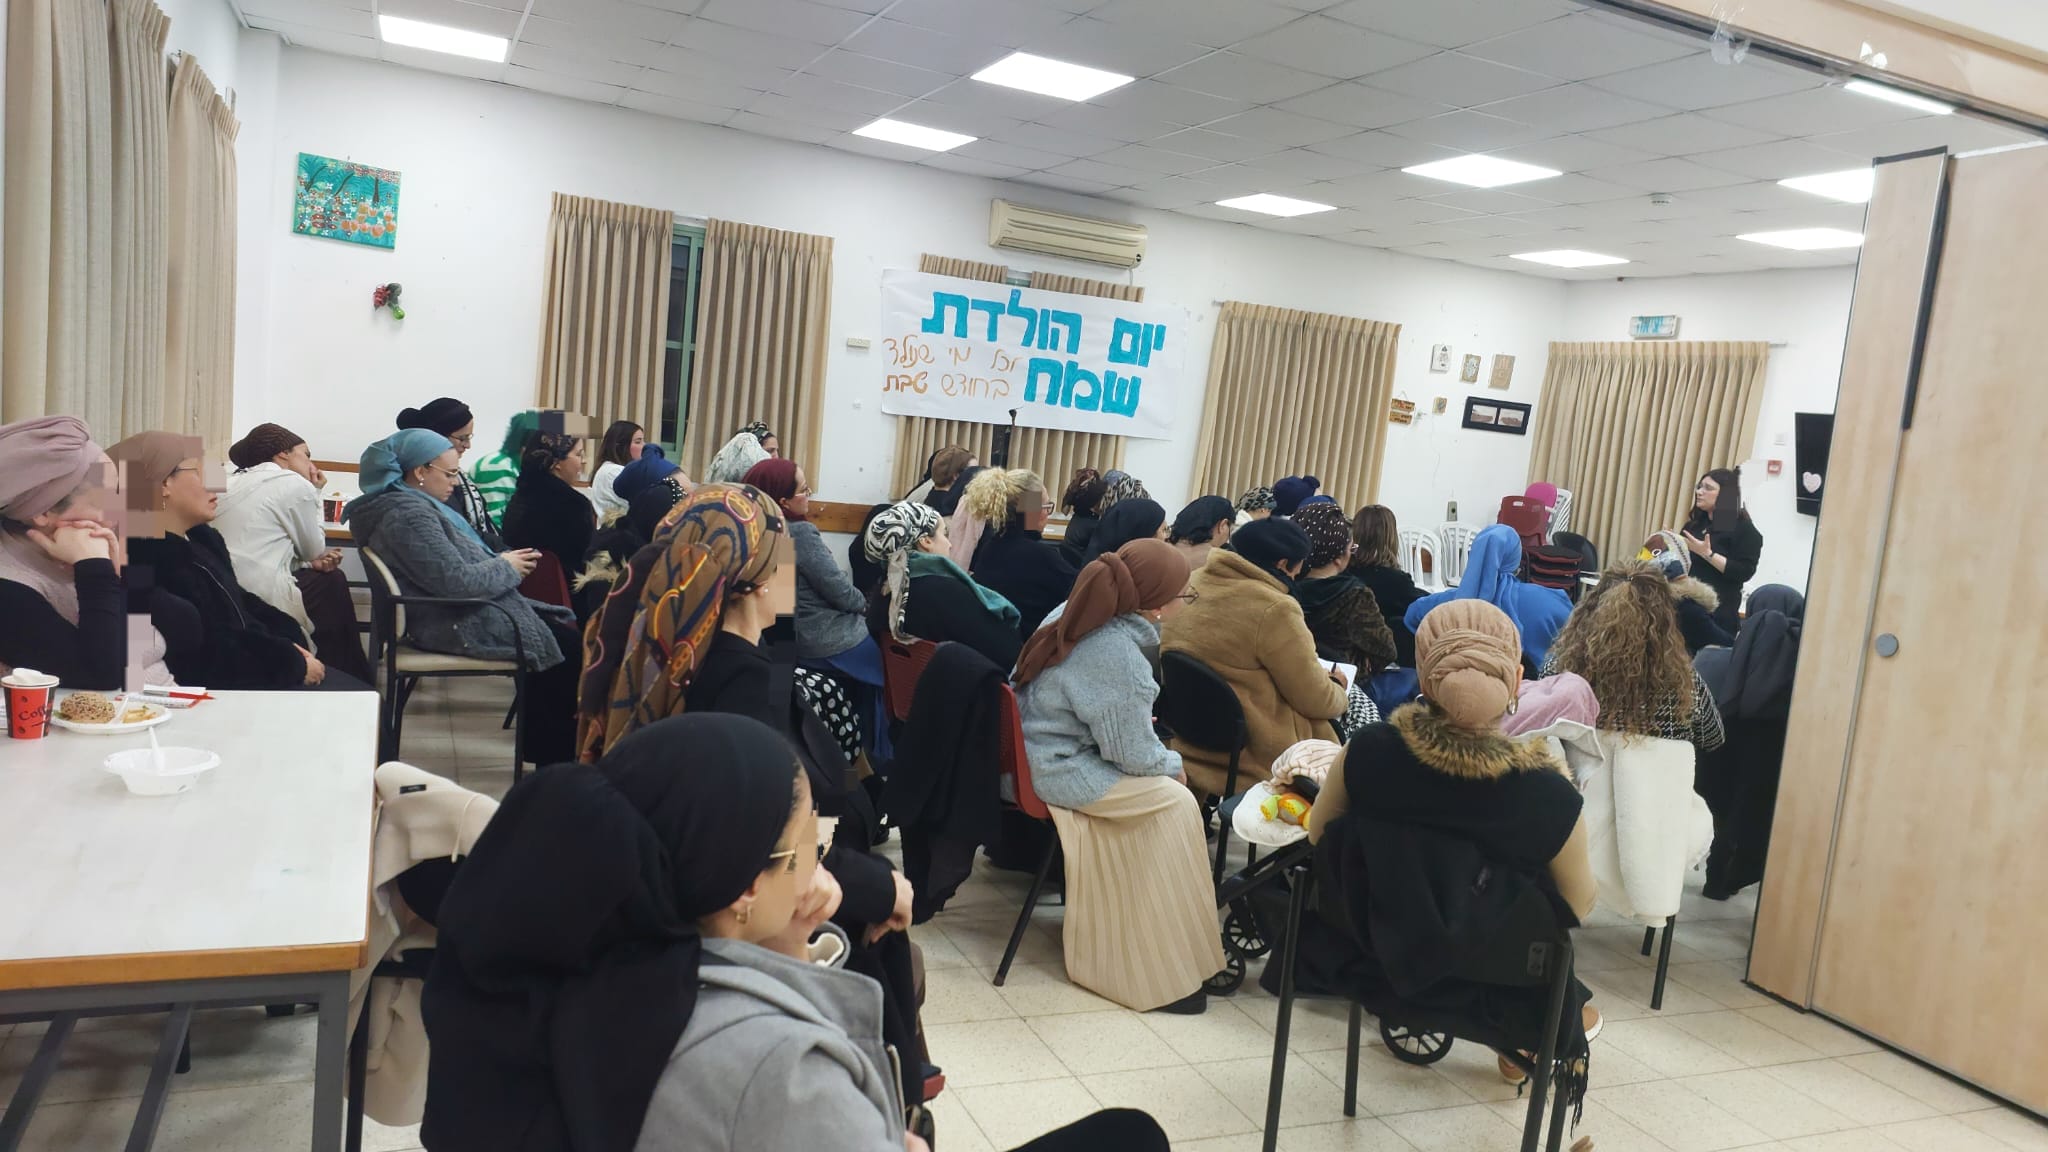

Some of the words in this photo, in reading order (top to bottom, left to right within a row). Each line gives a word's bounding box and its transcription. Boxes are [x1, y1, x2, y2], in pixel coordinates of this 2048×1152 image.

[922, 288, 1083, 355] הולדת
[1108, 317, 1167, 368] יום
[882, 333, 935, 369] שנולד
[948, 346, 972, 366] מי
[941, 373, 1010, 400] בחודש
[1023, 357, 1142, 418] שמח
